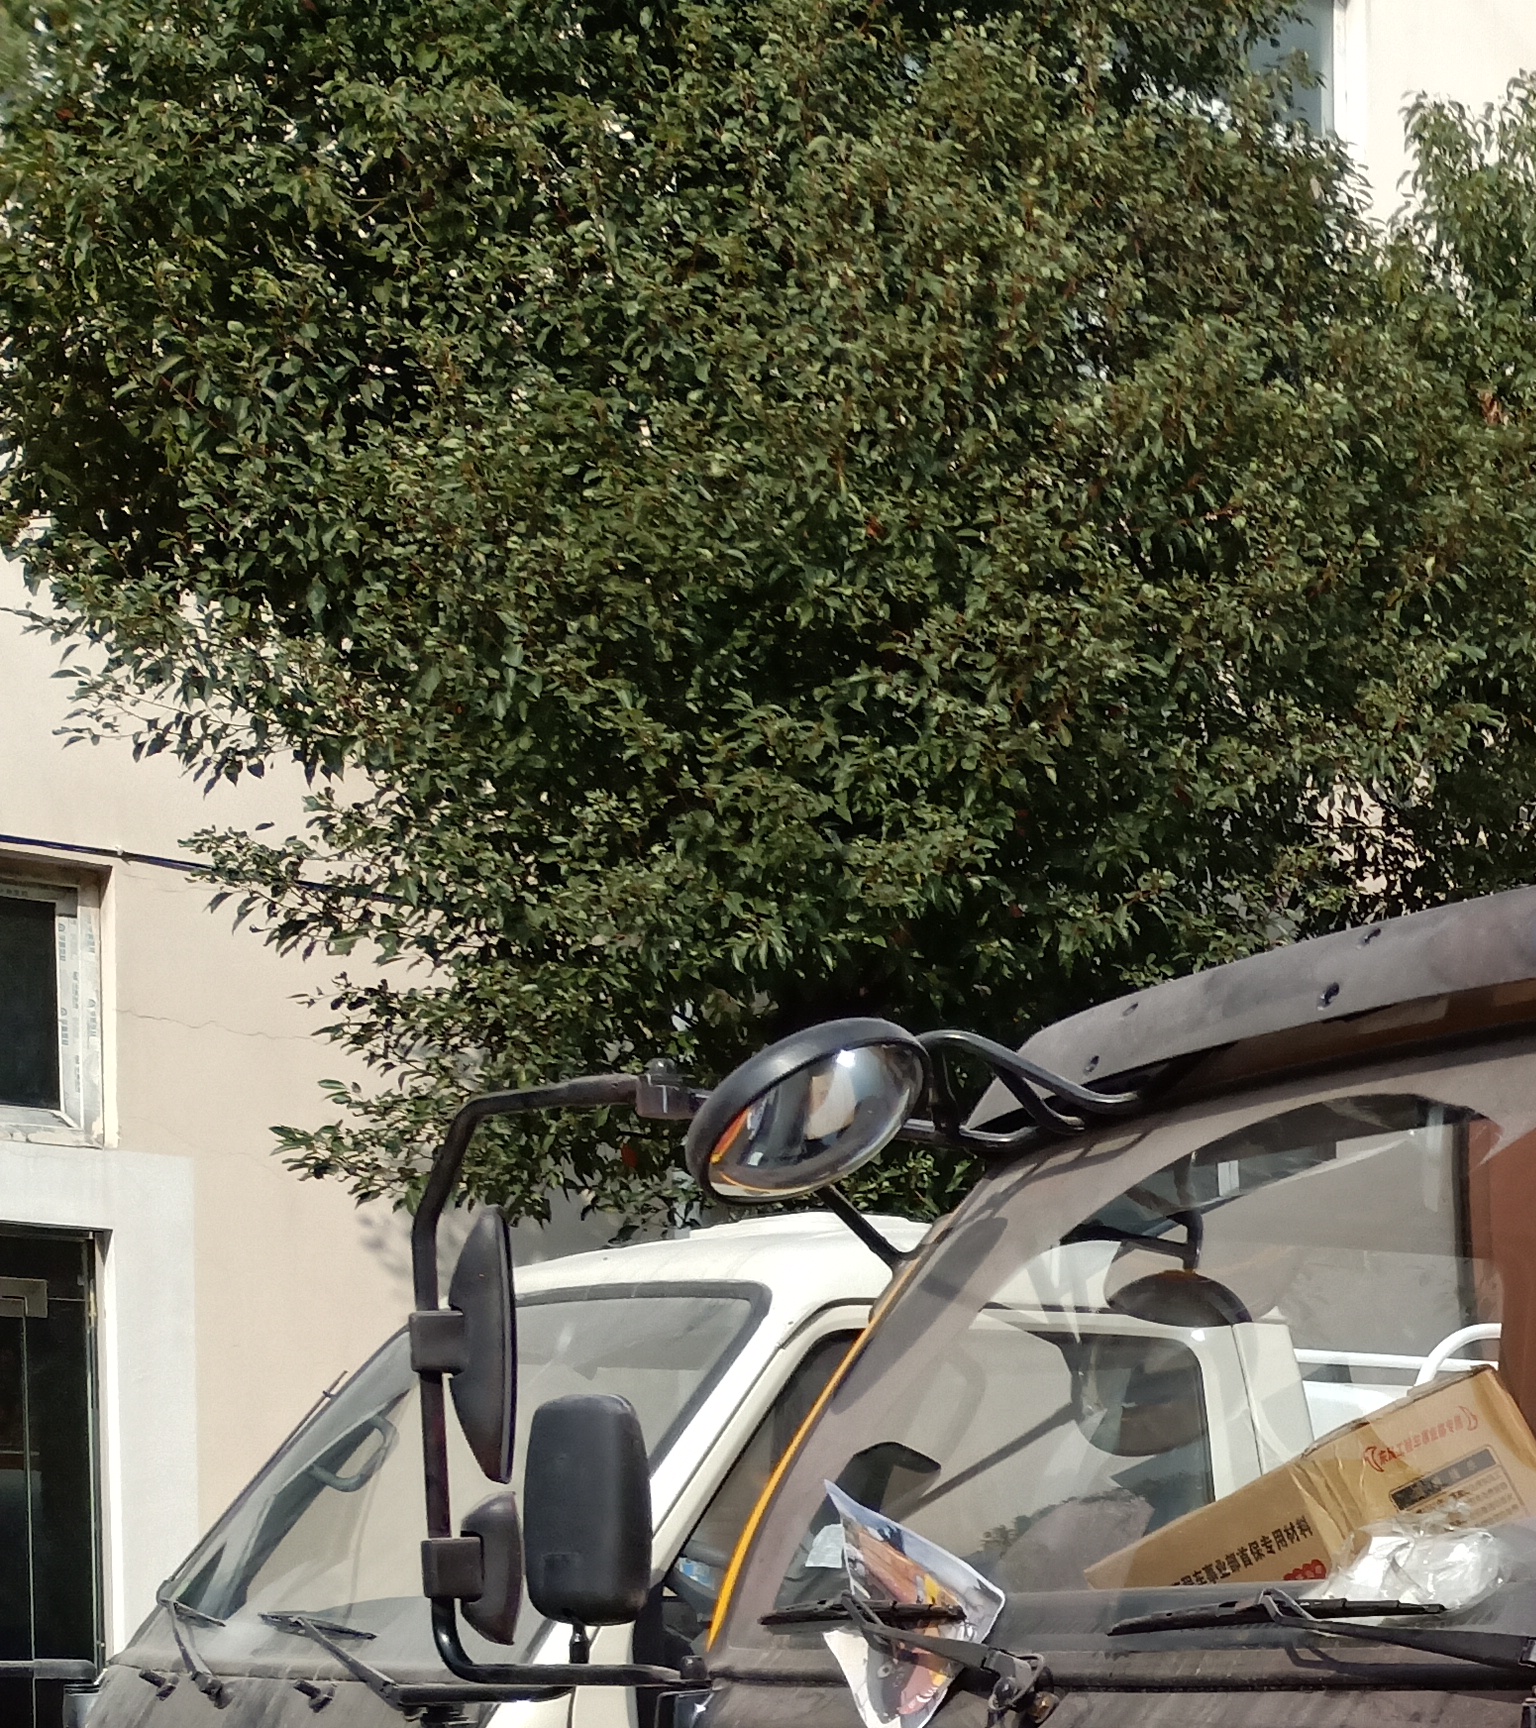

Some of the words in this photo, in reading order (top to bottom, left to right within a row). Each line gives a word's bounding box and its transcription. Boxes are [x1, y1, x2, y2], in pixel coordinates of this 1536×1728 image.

[1171, 1515, 1314, 1586] 程车事业部首保专用材料
